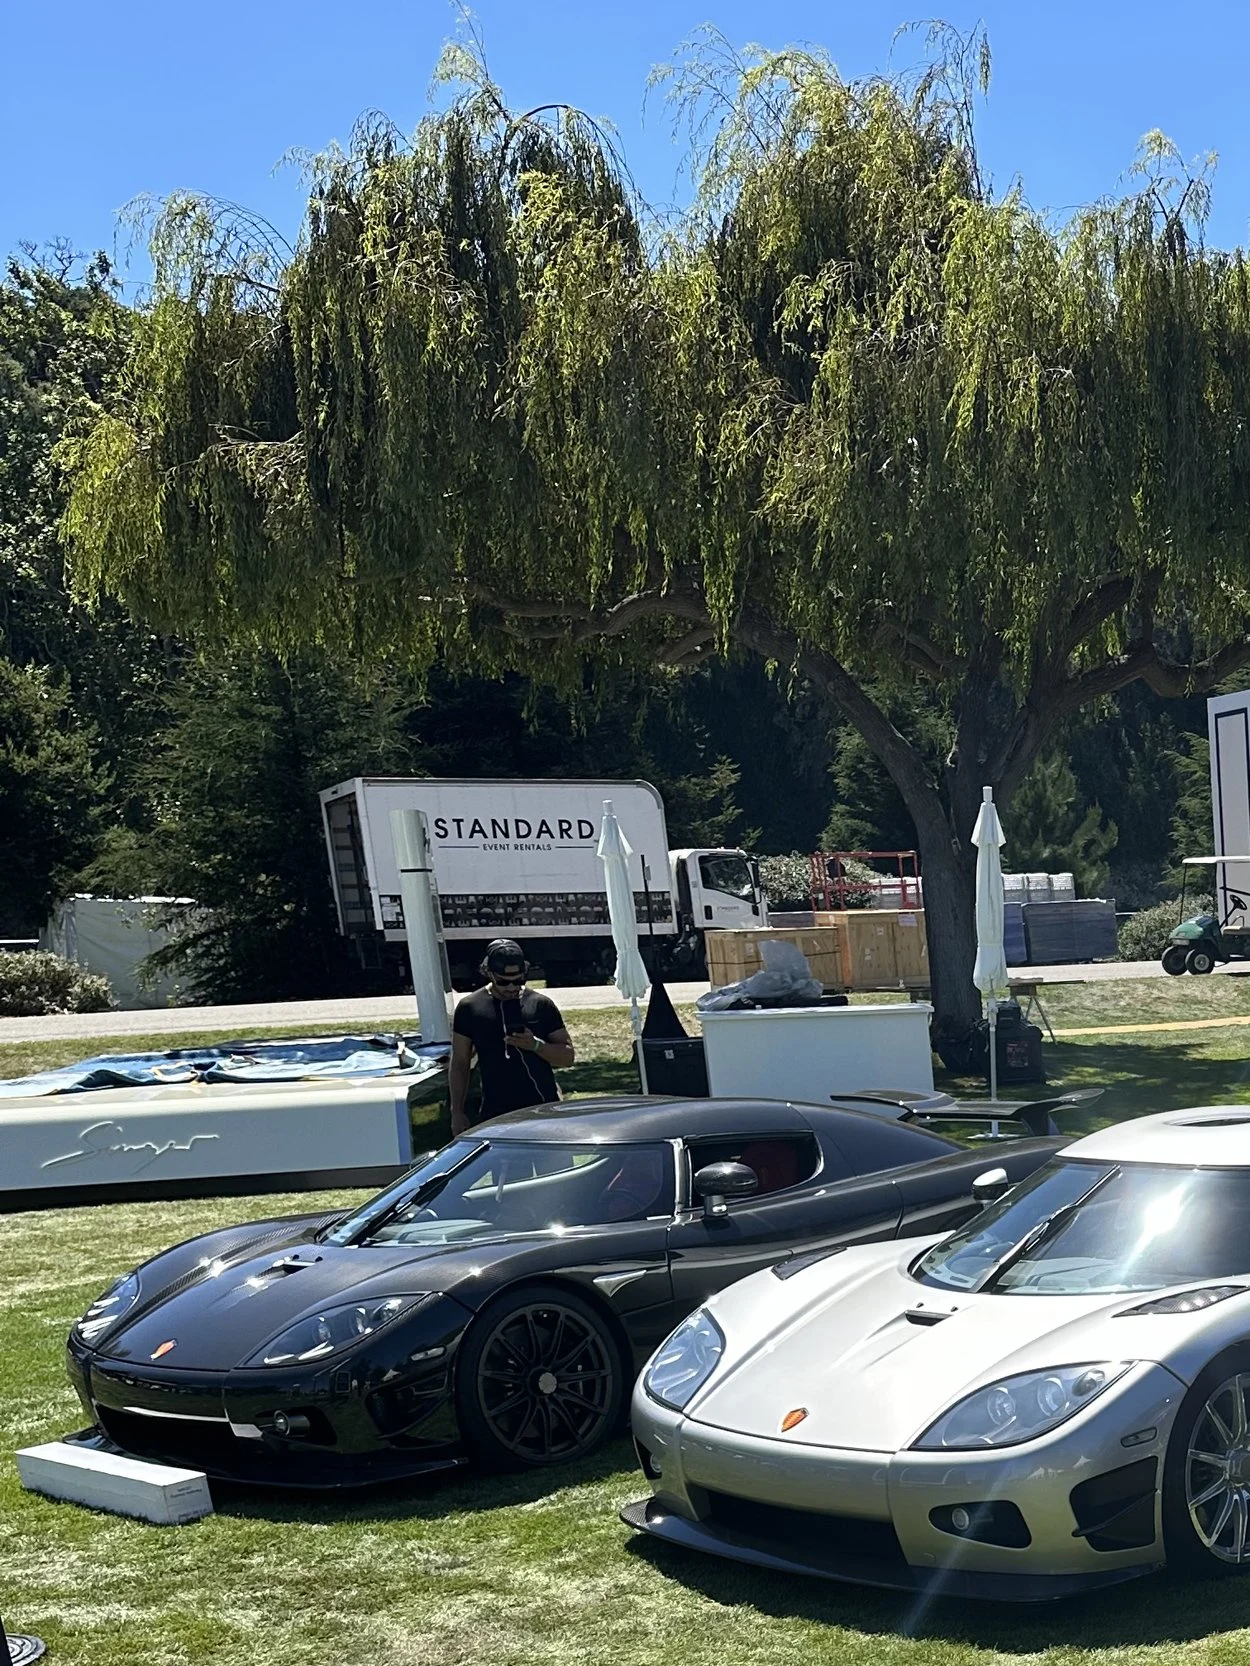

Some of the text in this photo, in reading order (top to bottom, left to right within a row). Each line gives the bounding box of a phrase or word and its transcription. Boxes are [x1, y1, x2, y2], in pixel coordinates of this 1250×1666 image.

[434, 818, 595, 839] STANDARD
[483, 843, 552, 851] EVENT RENTALS
